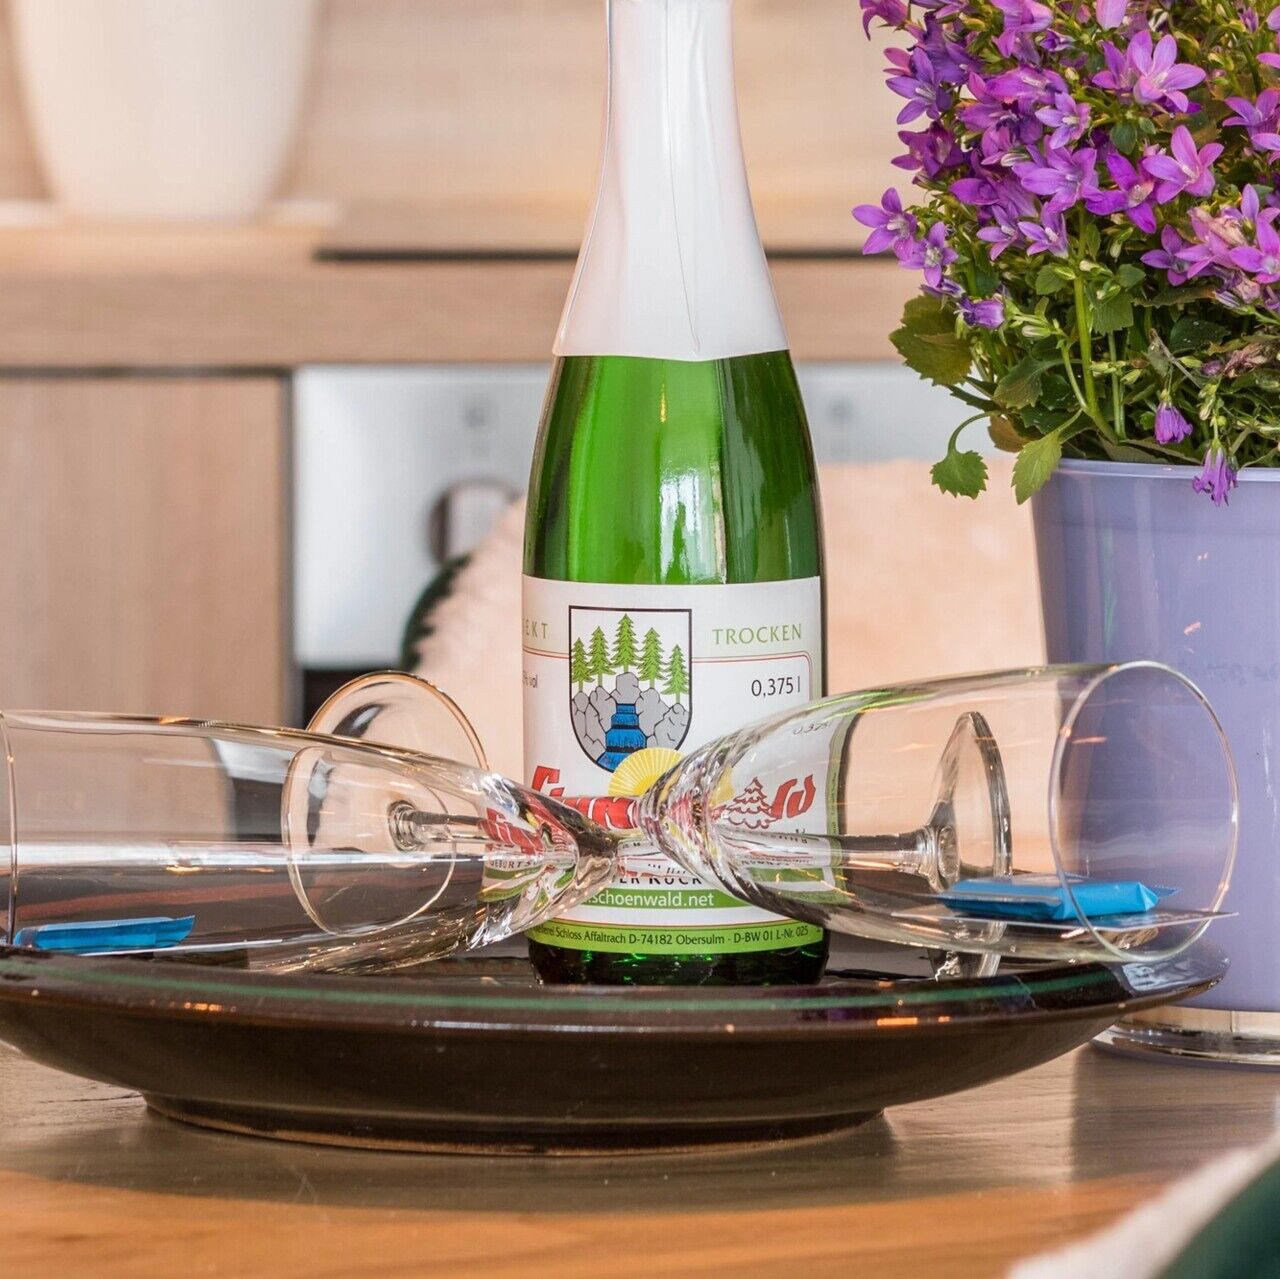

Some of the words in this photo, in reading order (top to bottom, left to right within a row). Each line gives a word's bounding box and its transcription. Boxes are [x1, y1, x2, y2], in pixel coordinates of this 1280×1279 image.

[523, 619, 548, 639] EKT
[712, 624, 802, 645] TROCKEN
[556, 926, 582, 941] Schloss
[584, 930, 626, 944] Affaltrach
[628, 933, 673, 945] D-74182
[675, 933, 725, 945] Obersulm
[733, 931, 761, 943] D-BW
